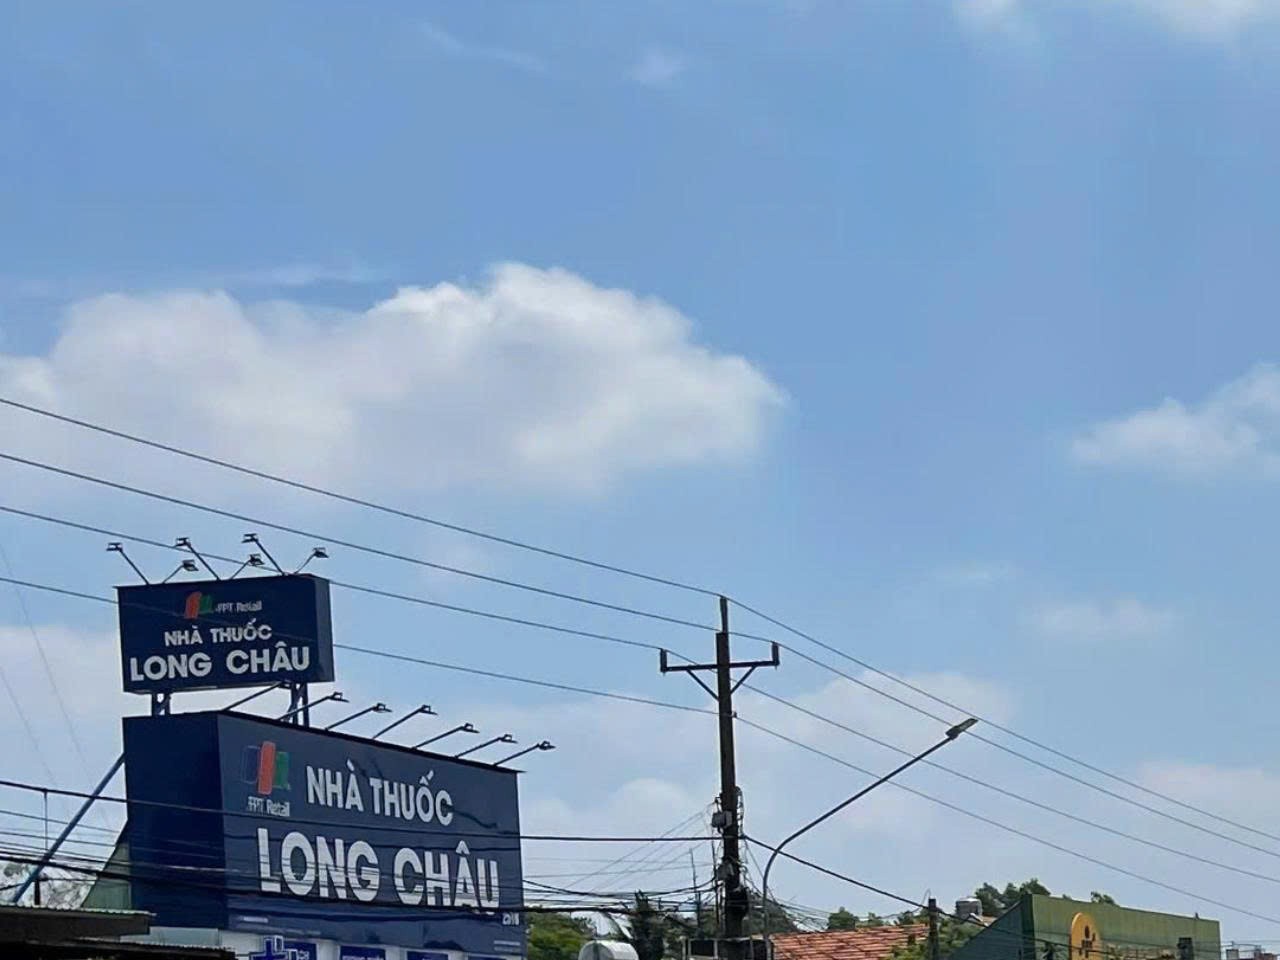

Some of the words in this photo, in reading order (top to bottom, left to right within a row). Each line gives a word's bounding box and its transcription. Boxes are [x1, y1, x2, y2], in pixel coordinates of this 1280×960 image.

[164, 625, 203, 647] NHÀ
[210, 618, 272, 643] THUỐC
[130, 653, 212, 681] LONG
[226, 641, 310, 674] CHÂU
[266, 799, 290, 817] Retail
[306, 759, 365, 812] NHÀ
[369, 770, 453, 826] THUỐC
[257, 827, 380, 901] LONG
[394, 840, 500, 914] CHÂU
